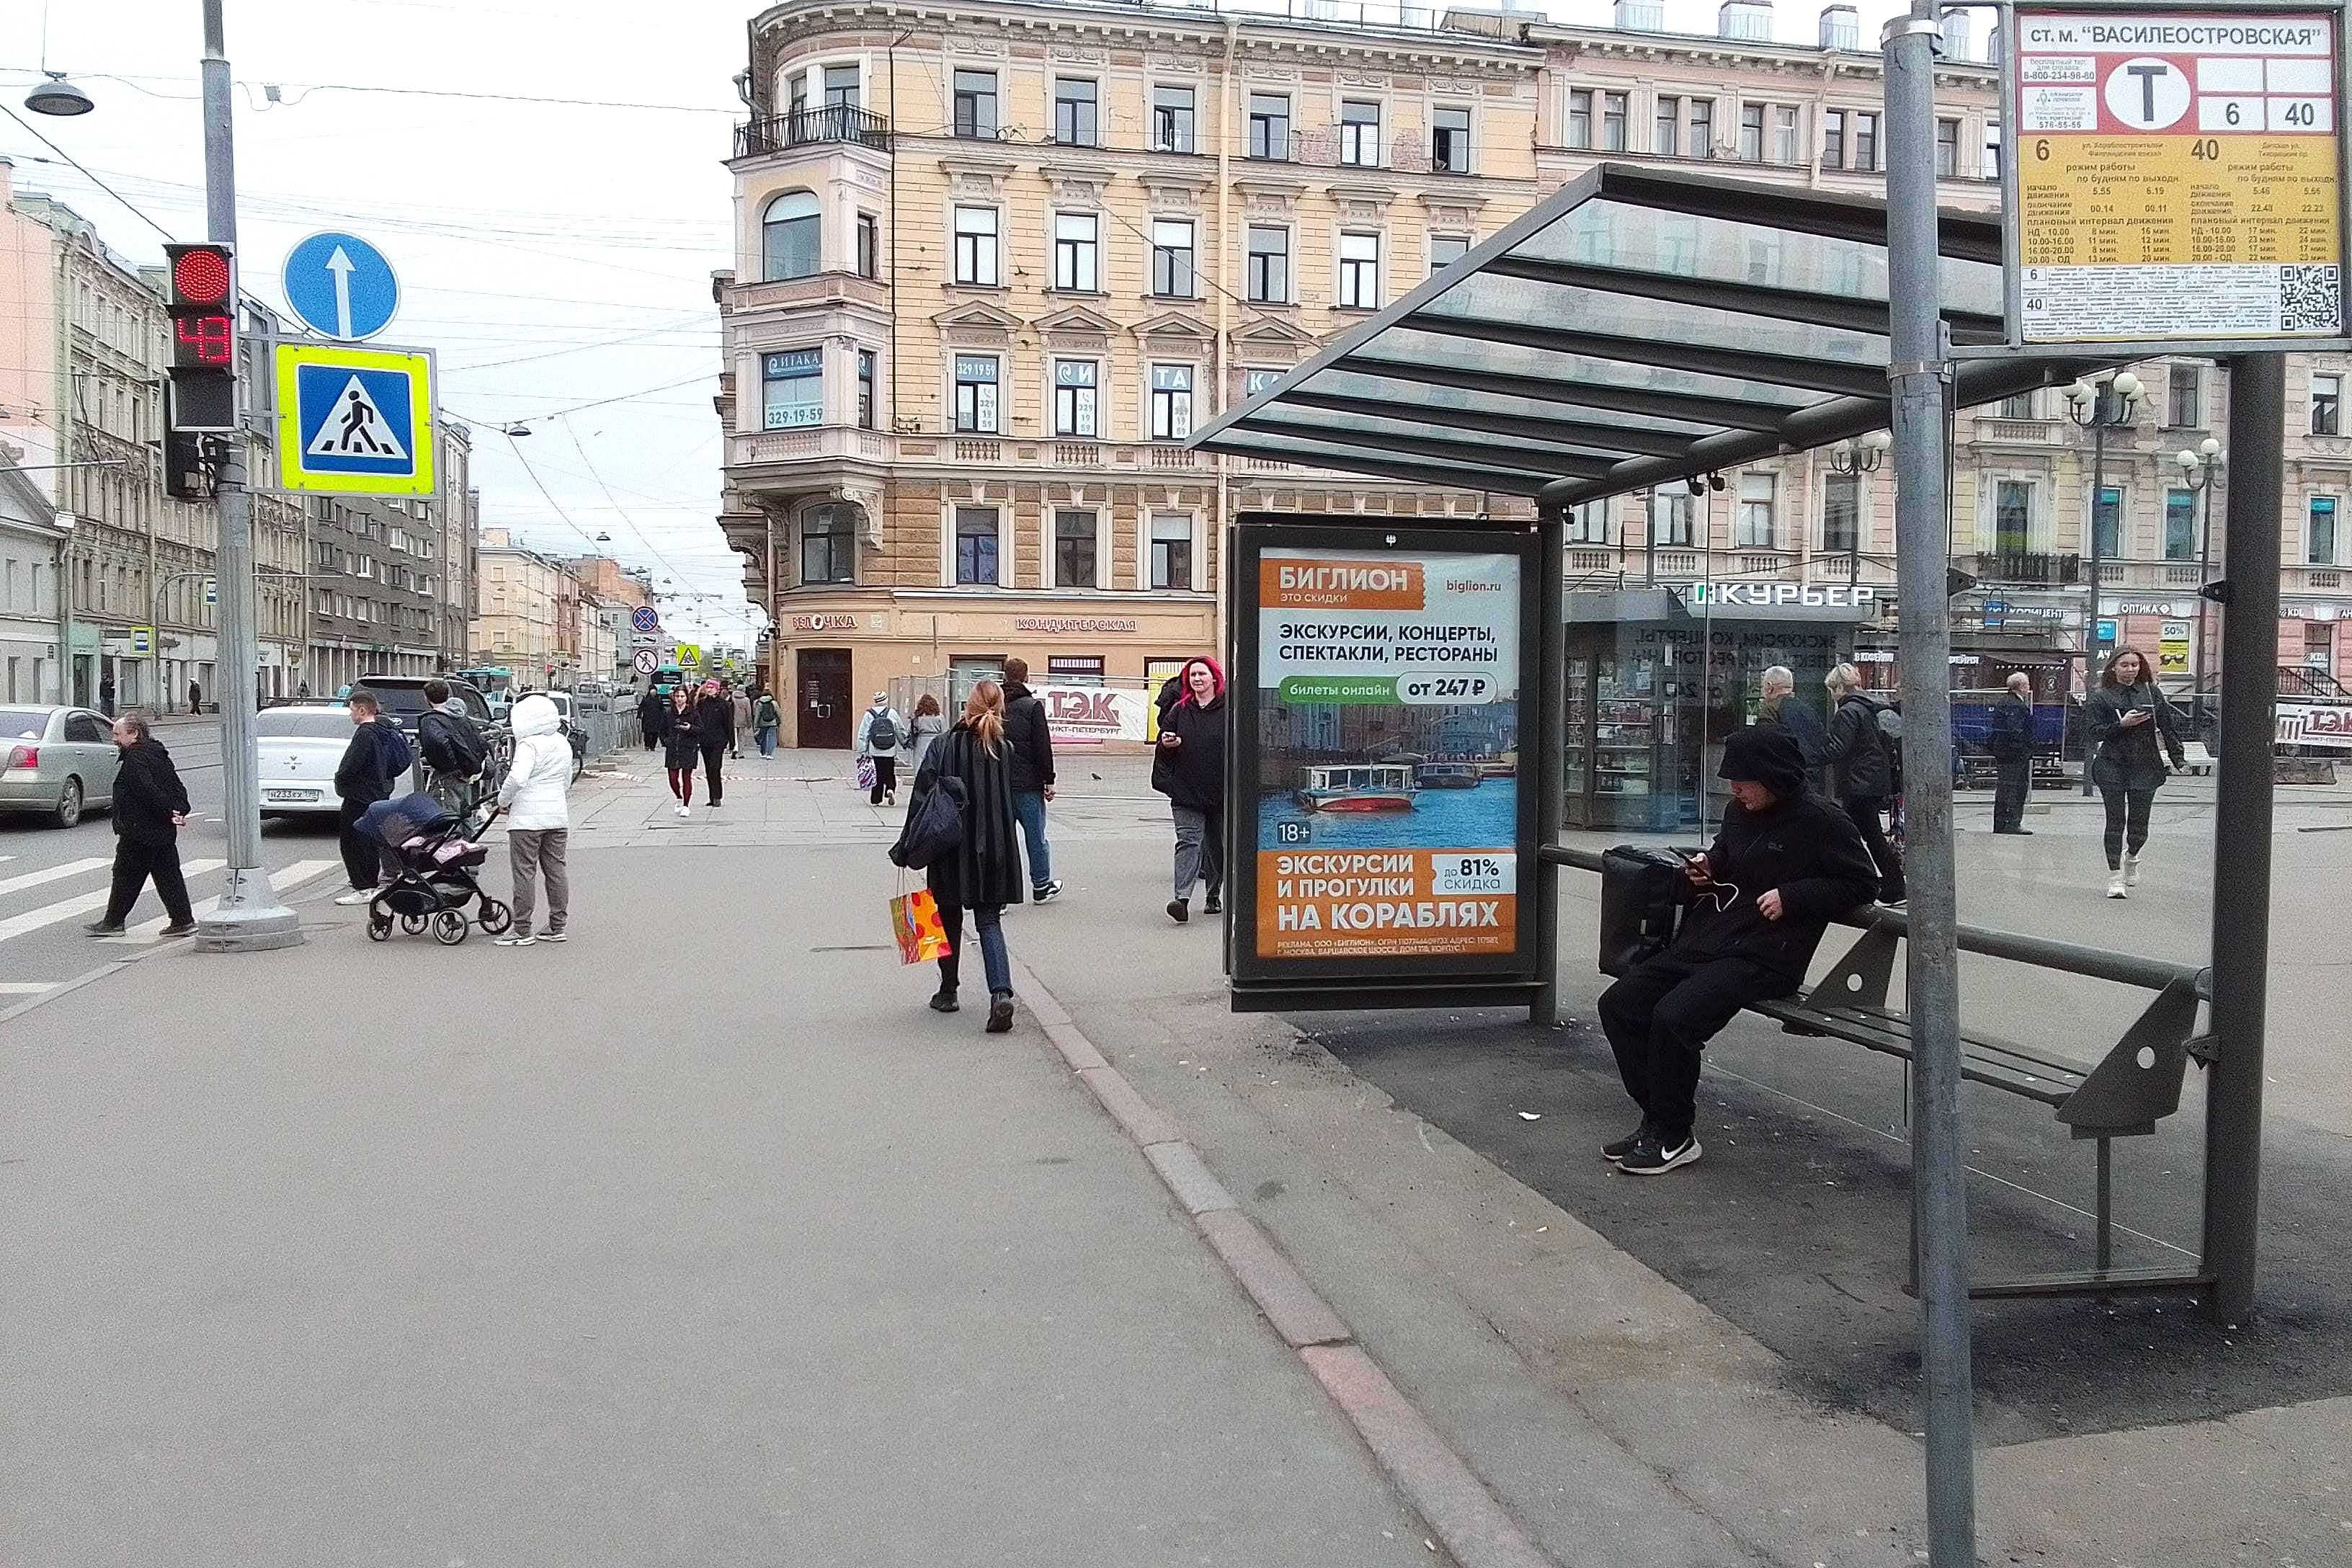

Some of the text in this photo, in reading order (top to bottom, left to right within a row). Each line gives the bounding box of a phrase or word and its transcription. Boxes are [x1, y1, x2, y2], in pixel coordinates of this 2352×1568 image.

[2226, 102, 2240, 125] 6
[2284, 102, 2315, 126] 40
[2036, 138, 2049, 161] 6
[2191, 138, 2219, 160] 40
[2100, 162, 2135, 172] работы
[2260, 162, 2294, 172] работы
[2080, 218, 2124, 227] интервал
[2030, 269, 2038, 280] 6
[2026, 298, 2042, 310] 40
[781, 353, 819, 368] ИТАКА
[957, 363, 996, 376] 329 19 59
[1279, 566, 1408, 592] БИГЛИОН
[1446, 579, 1502, 593] biglion.ru
[1721, 582, 1874, 607] КУРЬЕР
[2121, 603, 2158, 615] ОПТИКА
[793, 614, 858, 631] БЕЛОЧКА
[1017, 618, 1138, 633] КОНДИТЕРСКАЯ
[2164, 626, 2185, 636] 50%
[1279, 623, 1496, 643] ЭКСКУРСИИ, КОНЦЕРТЫ,
[1279, 645, 1498, 664] СПЕКТАКЛИ, РЕСТОРАНЫ
[1289, 682, 1390, 696] билеты онлайн
[1407, 683, 1431, 697] от
[1434, 679, 1469, 697] 247
[1048, 690, 1121, 724] ТЭК
[1278, 824, 1311, 842] 18+
[1276, 854, 1414, 875] ЭКСКУРСИИ
[1460, 858, 1500, 877] 81%
[1277, 877, 1414, 899] И ПРОГУЛКИ
[1278, 901, 1500, 932] НА КОРАБЛЯХ
